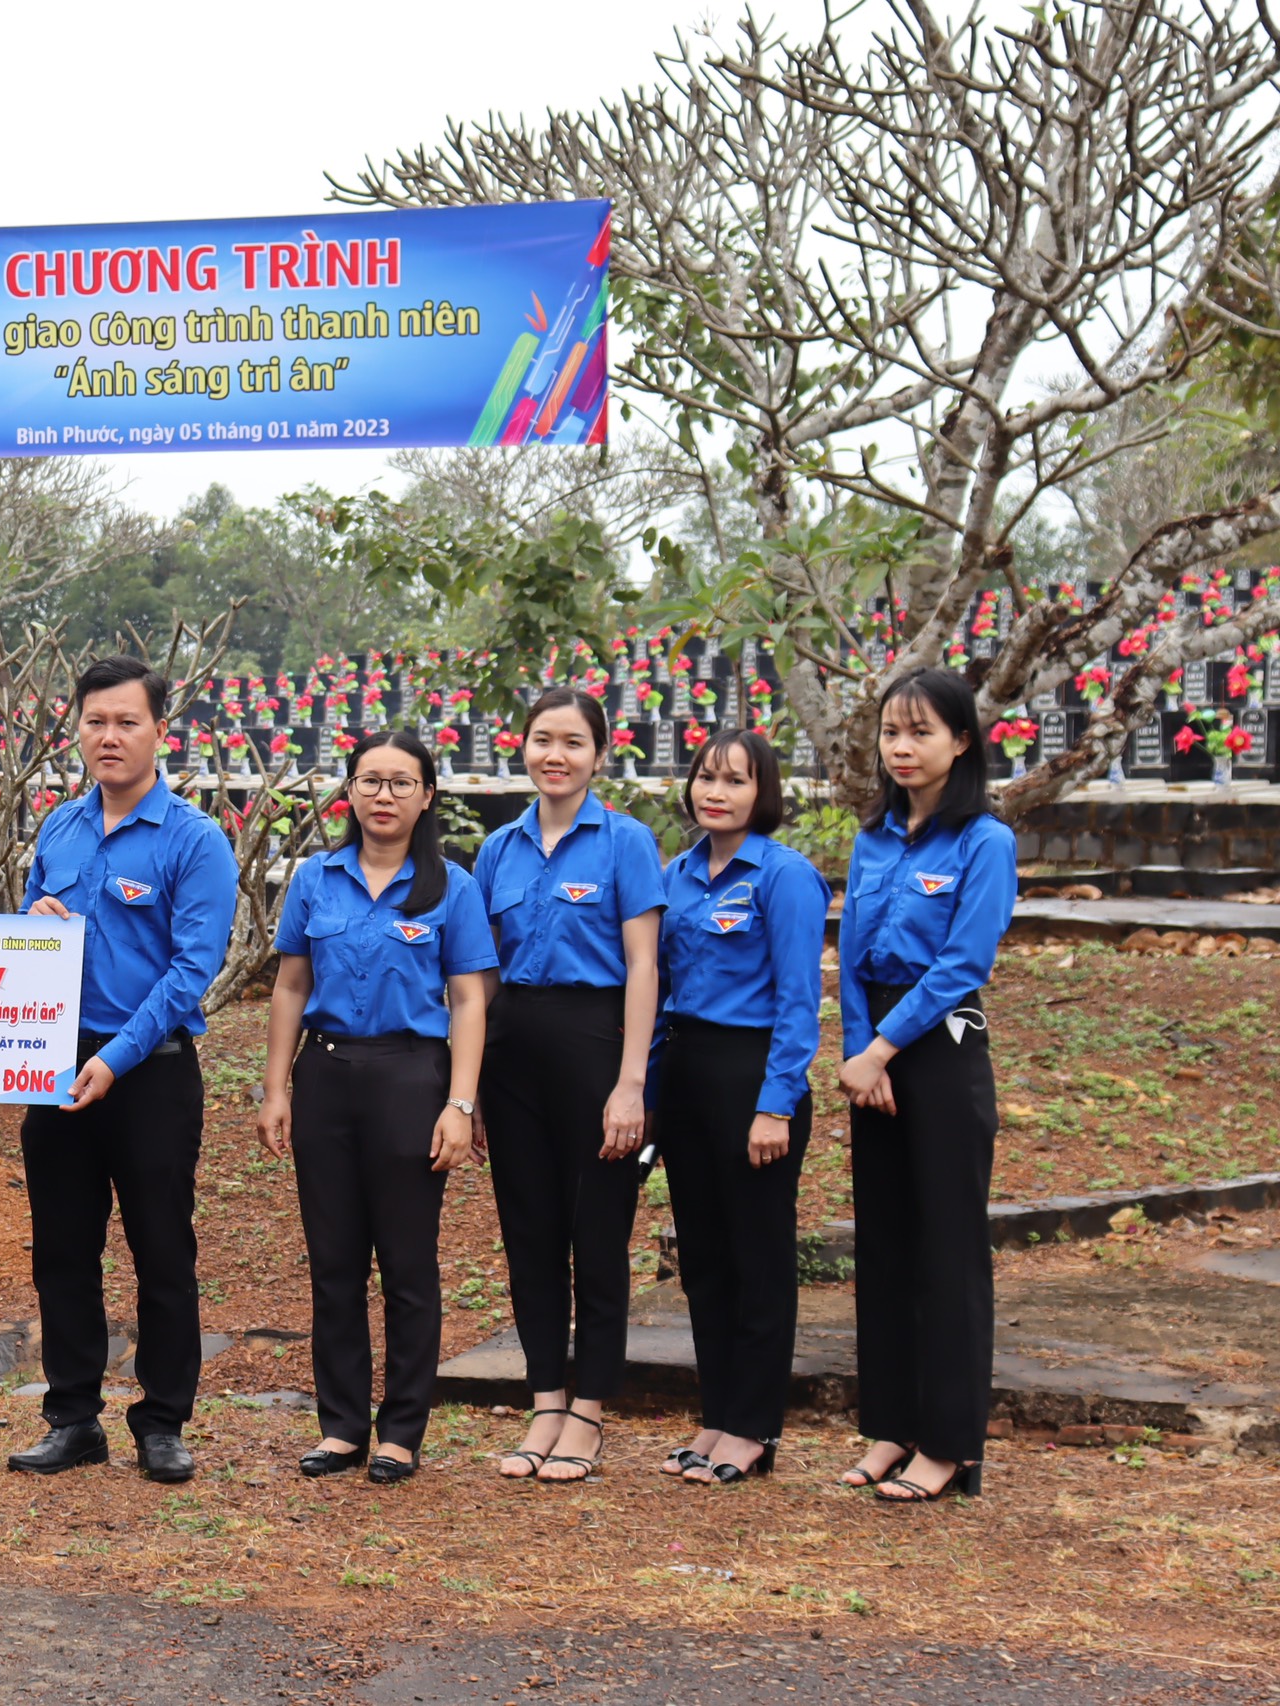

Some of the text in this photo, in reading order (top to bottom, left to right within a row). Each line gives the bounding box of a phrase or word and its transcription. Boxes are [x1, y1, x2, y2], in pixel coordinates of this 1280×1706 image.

[5, 230, 400, 298] CHƯƠNG TRÌNH
[4, 313, 82, 355] giao
[90, 311, 176, 350] Công
[185, 306, 273, 343] trình
[282, 302, 389, 340] thanh
[399, 300, 480, 337] niên
[145, 359, 229, 400] sáng
[238, 356, 281, 392] tri
[16, 418, 390, 445] Bình Phước, ngày 05 tháng 01 năm 2023
[2, 934, 26, 951] BÌNH
[22, 1000, 38, 1021] tri
[17, 1037, 47, 1050] TRỜI
[3, 1060, 56, 1093] ĐỒNG
